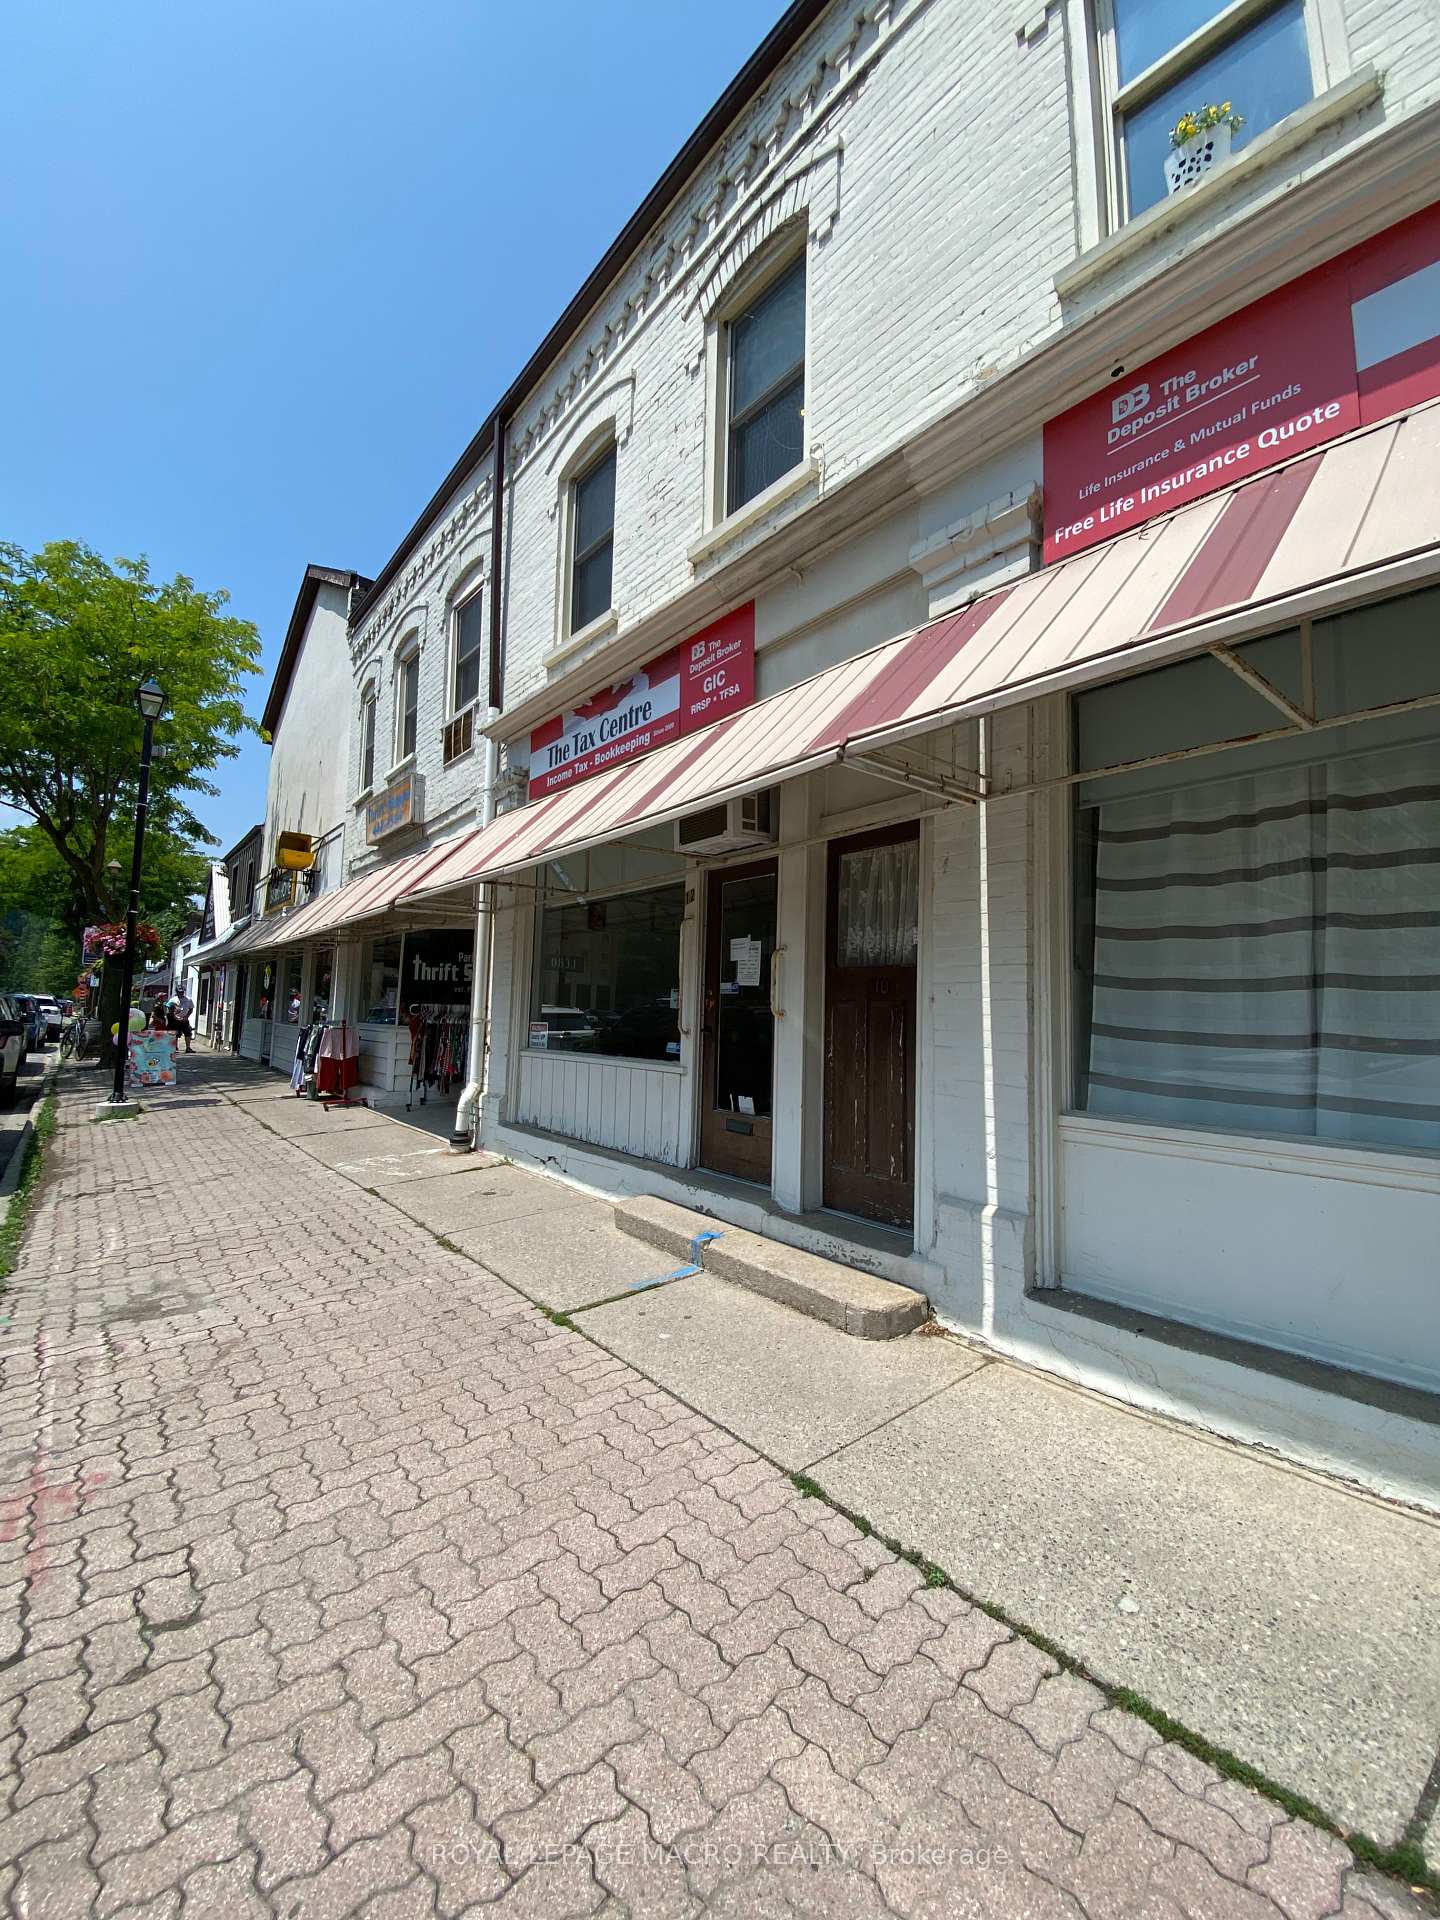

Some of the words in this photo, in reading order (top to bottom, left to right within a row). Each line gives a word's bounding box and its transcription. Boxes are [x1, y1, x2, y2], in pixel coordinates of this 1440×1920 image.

[1160, 369, 1198, 396] The
[1107, 394, 1181, 445] Deposit
[1186, 355, 1259, 403] Broker
[1079, 480, 1102, 500] Life
[1104, 448, 1170, 489] Insurance
[1173, 438, 1186, 453] &
[1190, 411, 1247, 448] Mutual
[1251, 383, 1302, 415] Funds
[1055, 515, 1094, 544] Free
[1100, 497, 1135, 524] Life
[1141, 442, 1251, 504] Insurance
[1257, 402, 1342, 449] Quote
[689, 652, 717, 674] Deposit
[716, 640, 742, 660] Broker
[708, 639, 721, 652] The
[703, 670, 726, 694] GIC
[690, 697, 711, 716] RRSP
[719, 683, 740, 701] TFSA
[547, 743, 571, 769] The
[572, 729, 598, 755] Tax
[600, 700, 652, 743] Centre
[546, 768, 573, 788] Income
[574, 761, 588, 775] Tax
[594, 732, 651, 766] Bookkeeping
[413, 952, 459, 981] thrift
